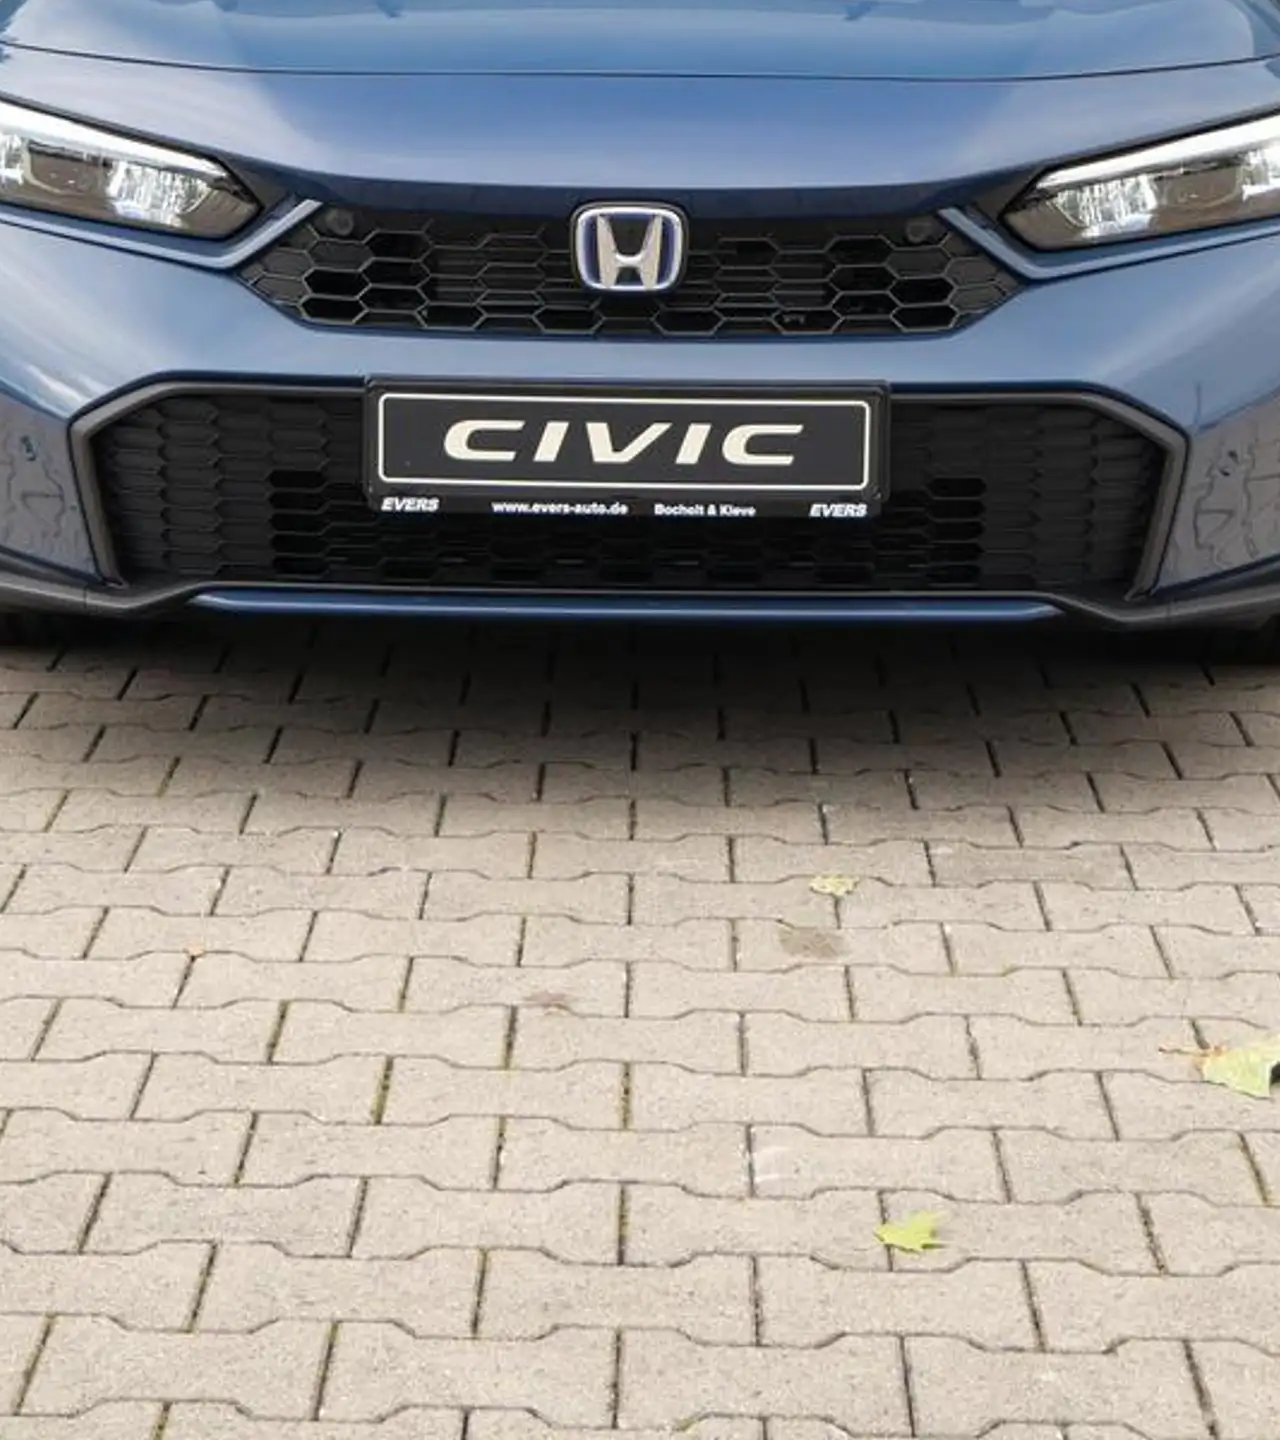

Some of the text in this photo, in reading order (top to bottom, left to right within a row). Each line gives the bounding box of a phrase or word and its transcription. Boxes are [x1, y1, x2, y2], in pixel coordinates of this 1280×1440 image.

[444, 420, 803, 465] CIVIC
[381, 497, 439, 512] EVERS
[491, 502, 629, 515] www.evers-auto.de
[809, 504, 868, 518] EVERS
